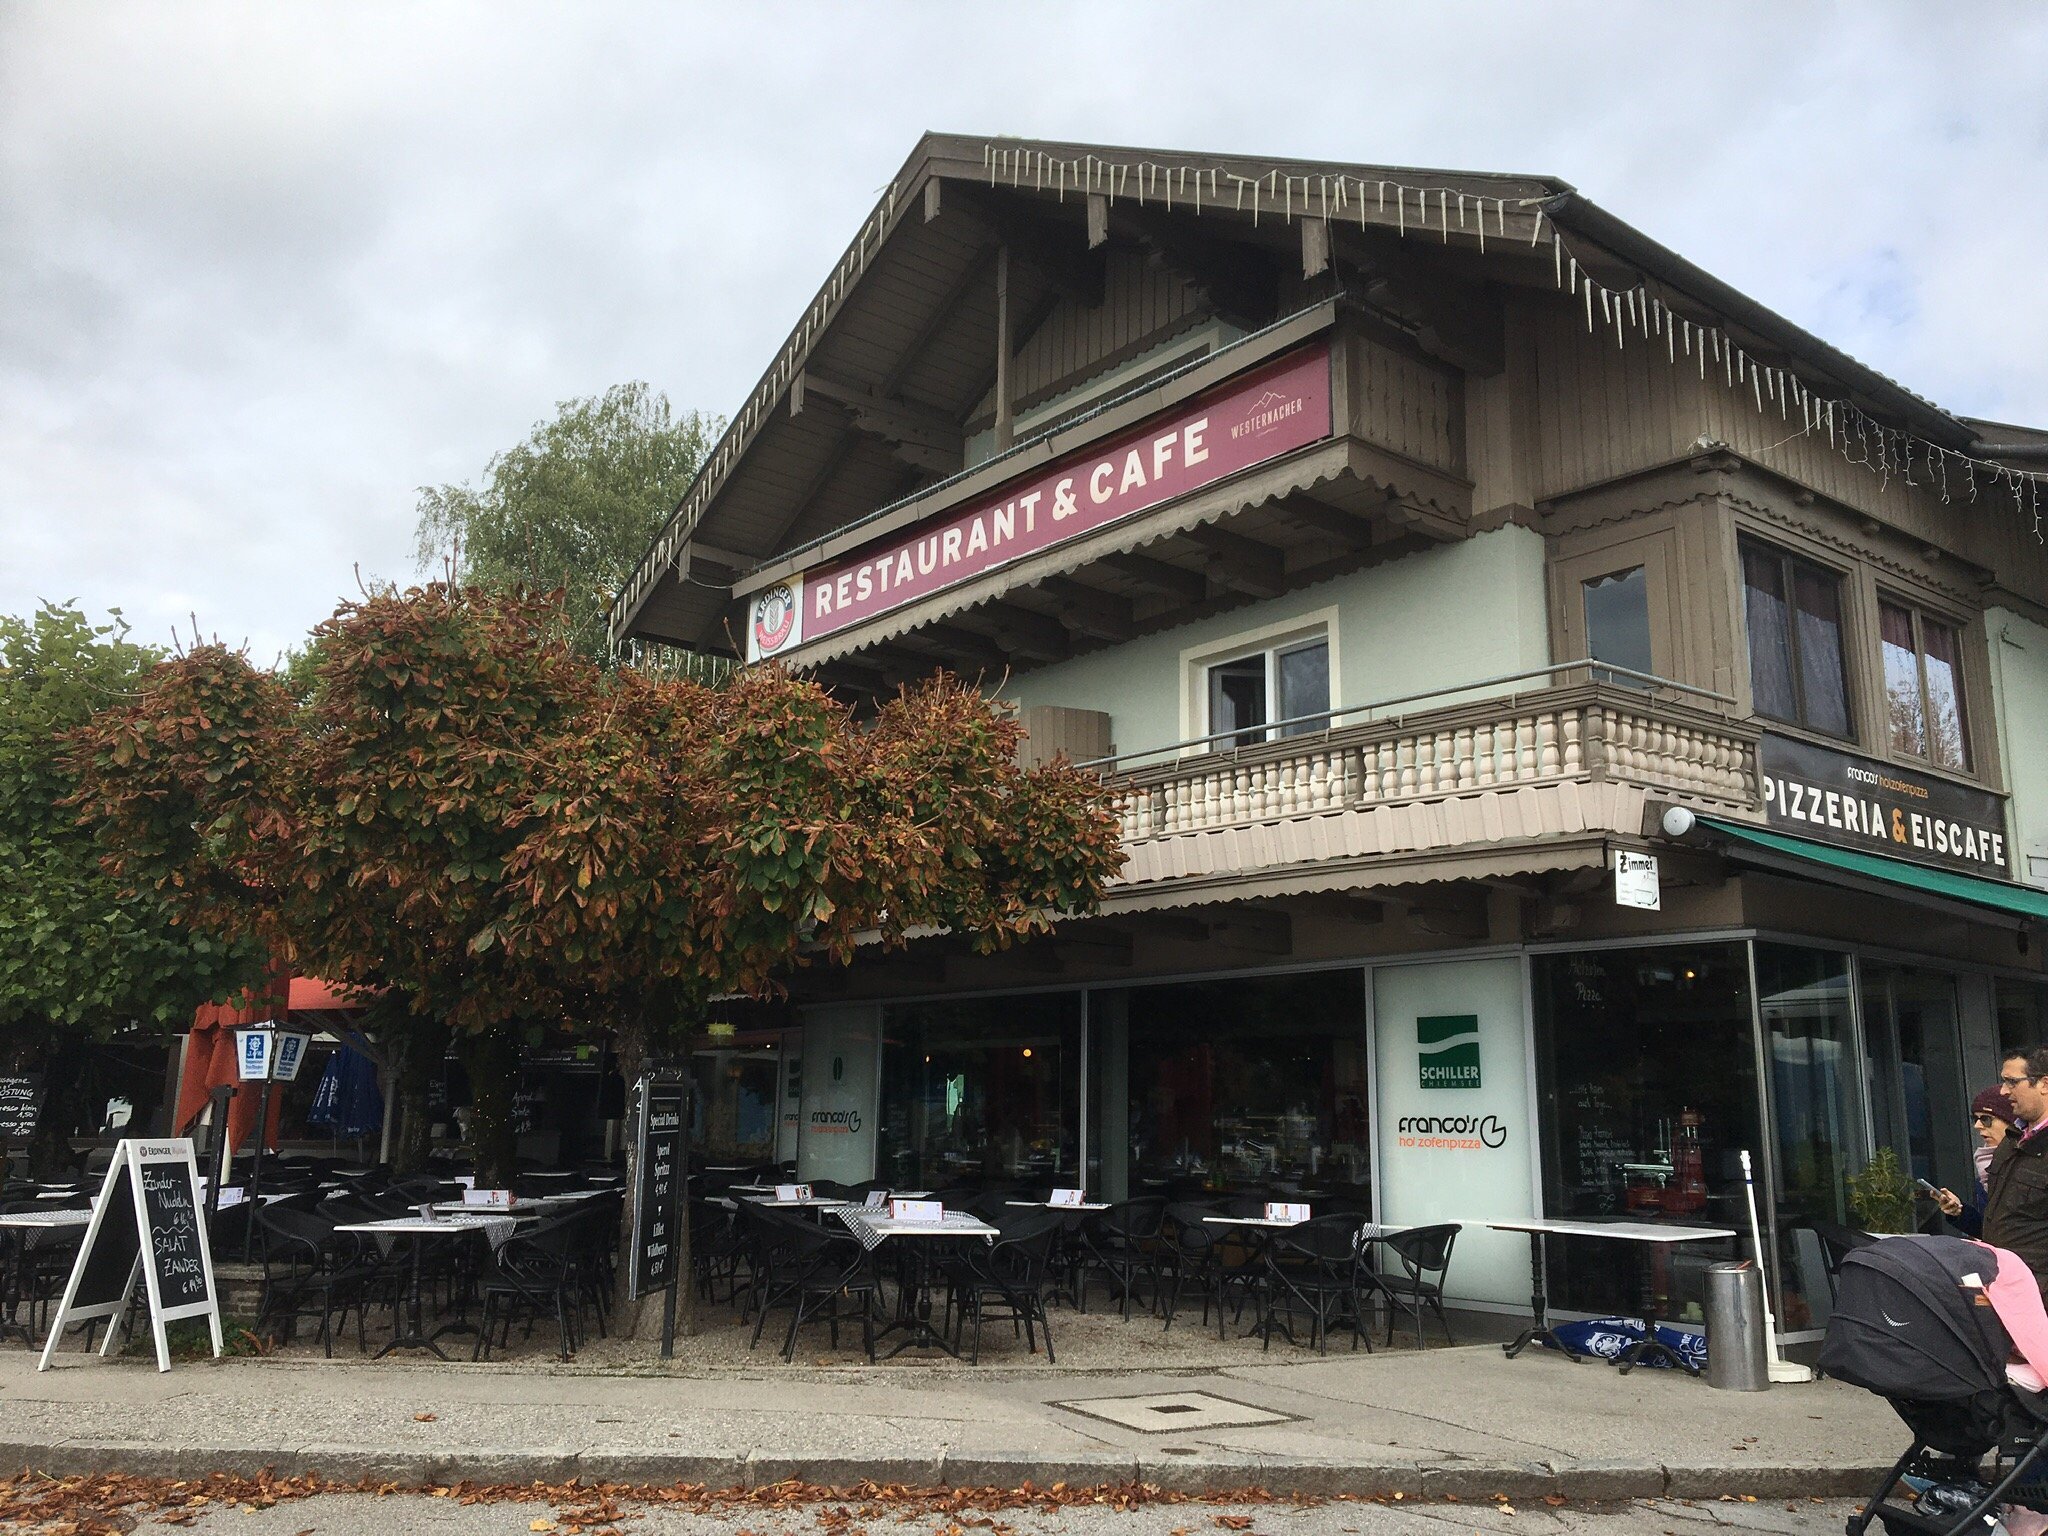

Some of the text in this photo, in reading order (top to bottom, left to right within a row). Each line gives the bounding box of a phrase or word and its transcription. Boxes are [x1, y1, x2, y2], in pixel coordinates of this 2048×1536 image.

[1231, 398, 1303, 440] WESTERNACHER
[814, 416, 1211, 619] RESTAURANT & CAFE
[757, 586, 792, 618] ERDINGER
[1764, 775, 2006, 867] PIZZERIA & EISCAFE
[1619, 854, 1653, 874] Zimmer
[1421, 1065, 1480, 1080] SCHILLER
[1421, 1080, 1481, 1089] CHIEMSEE
[651, 1112, 680, 1130] Special Drinks
[1398, 1115, 1480, 1134] franco's
[147, 1146, 172, 1157] ERDINGER
[154, 1235, 189, 1256] SALAT
[164, 1257, 202, 1277] ZANDER
